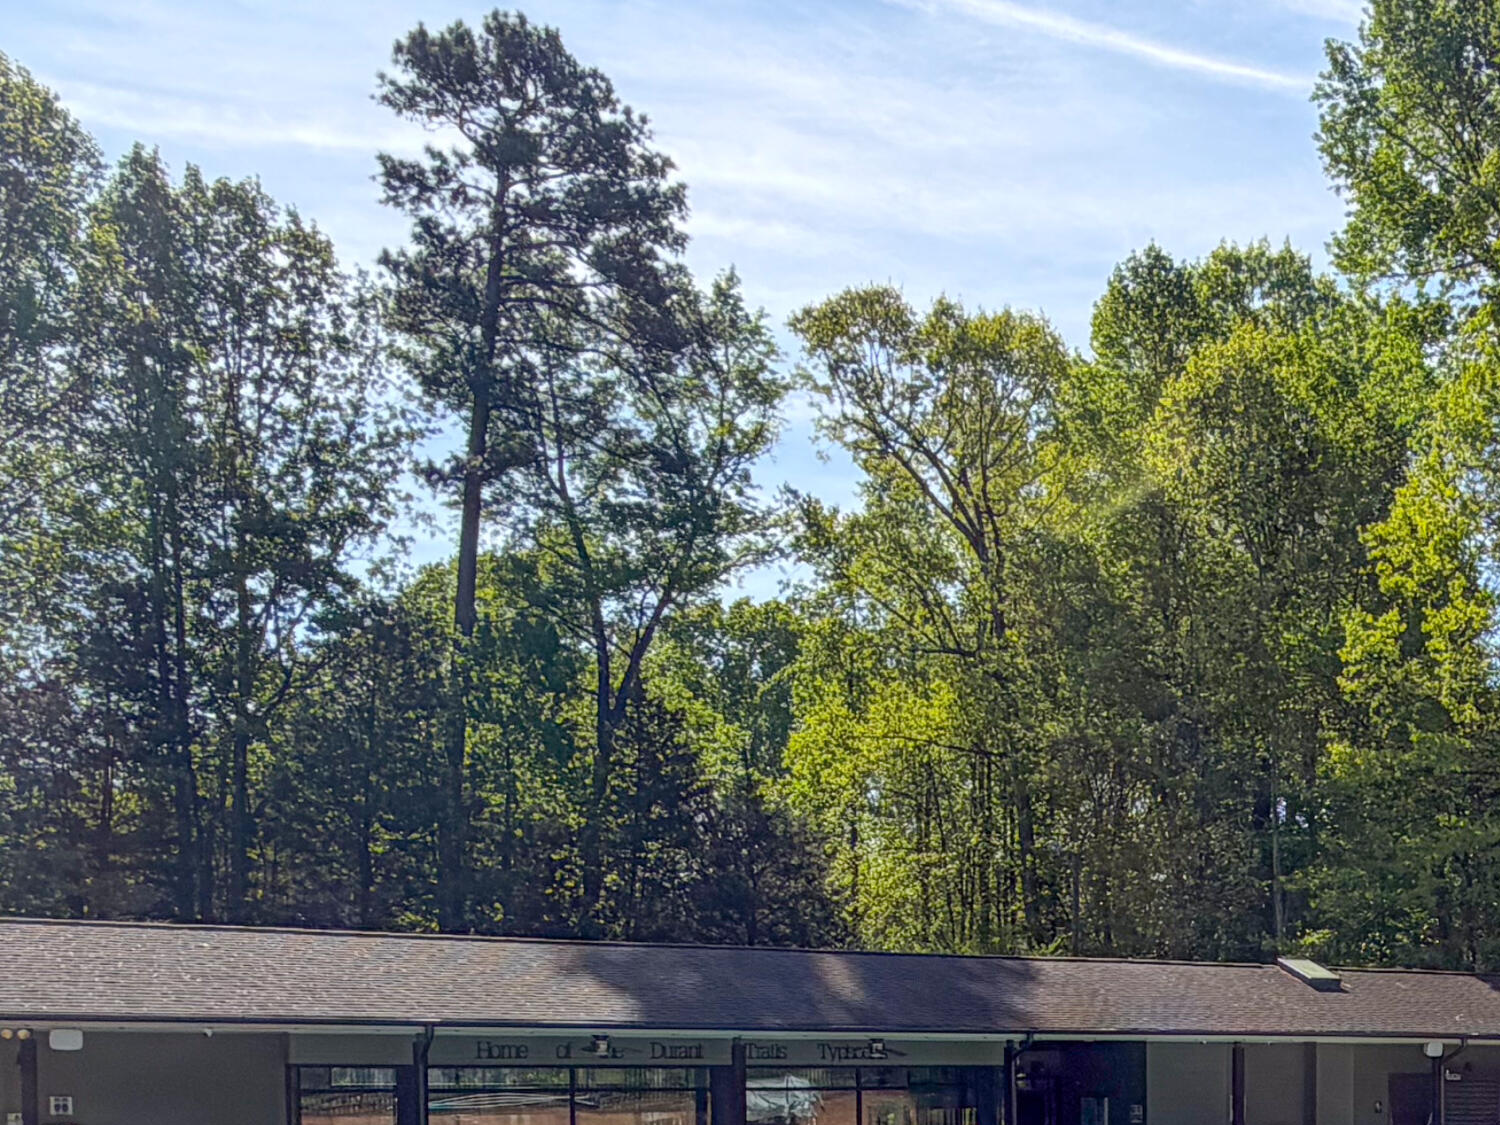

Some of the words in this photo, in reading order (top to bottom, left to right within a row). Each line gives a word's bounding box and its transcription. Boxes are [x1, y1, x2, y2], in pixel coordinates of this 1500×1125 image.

[475, 1041, 528, 1059] Home
[555, 1042, 573, 1059] of
[650, 1042, 705, 1059] Durant
[816, 1042, 888, 1063] Typhoo
